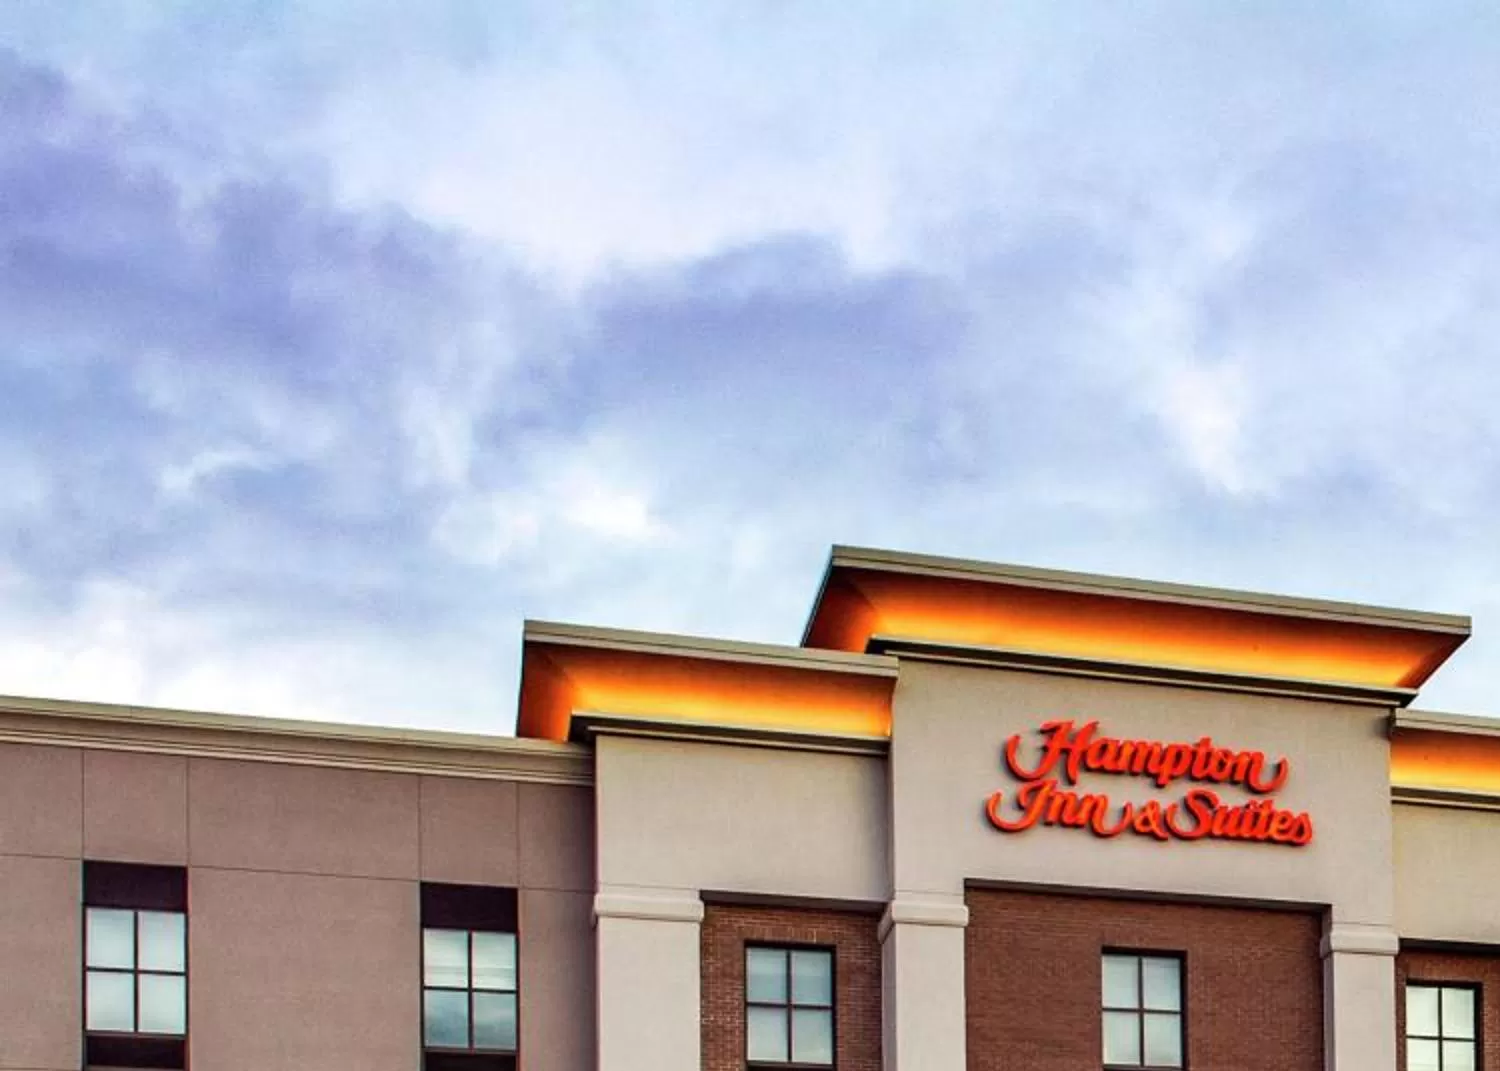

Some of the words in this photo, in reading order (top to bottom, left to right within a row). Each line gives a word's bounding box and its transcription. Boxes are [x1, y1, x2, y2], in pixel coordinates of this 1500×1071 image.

[1003, 720, 1289, 793] Hampton
[984, 779, 1134, 838] Inn
[1133, 800, 1169, 840] &
[1166, 788, 1313, 845] Suites
